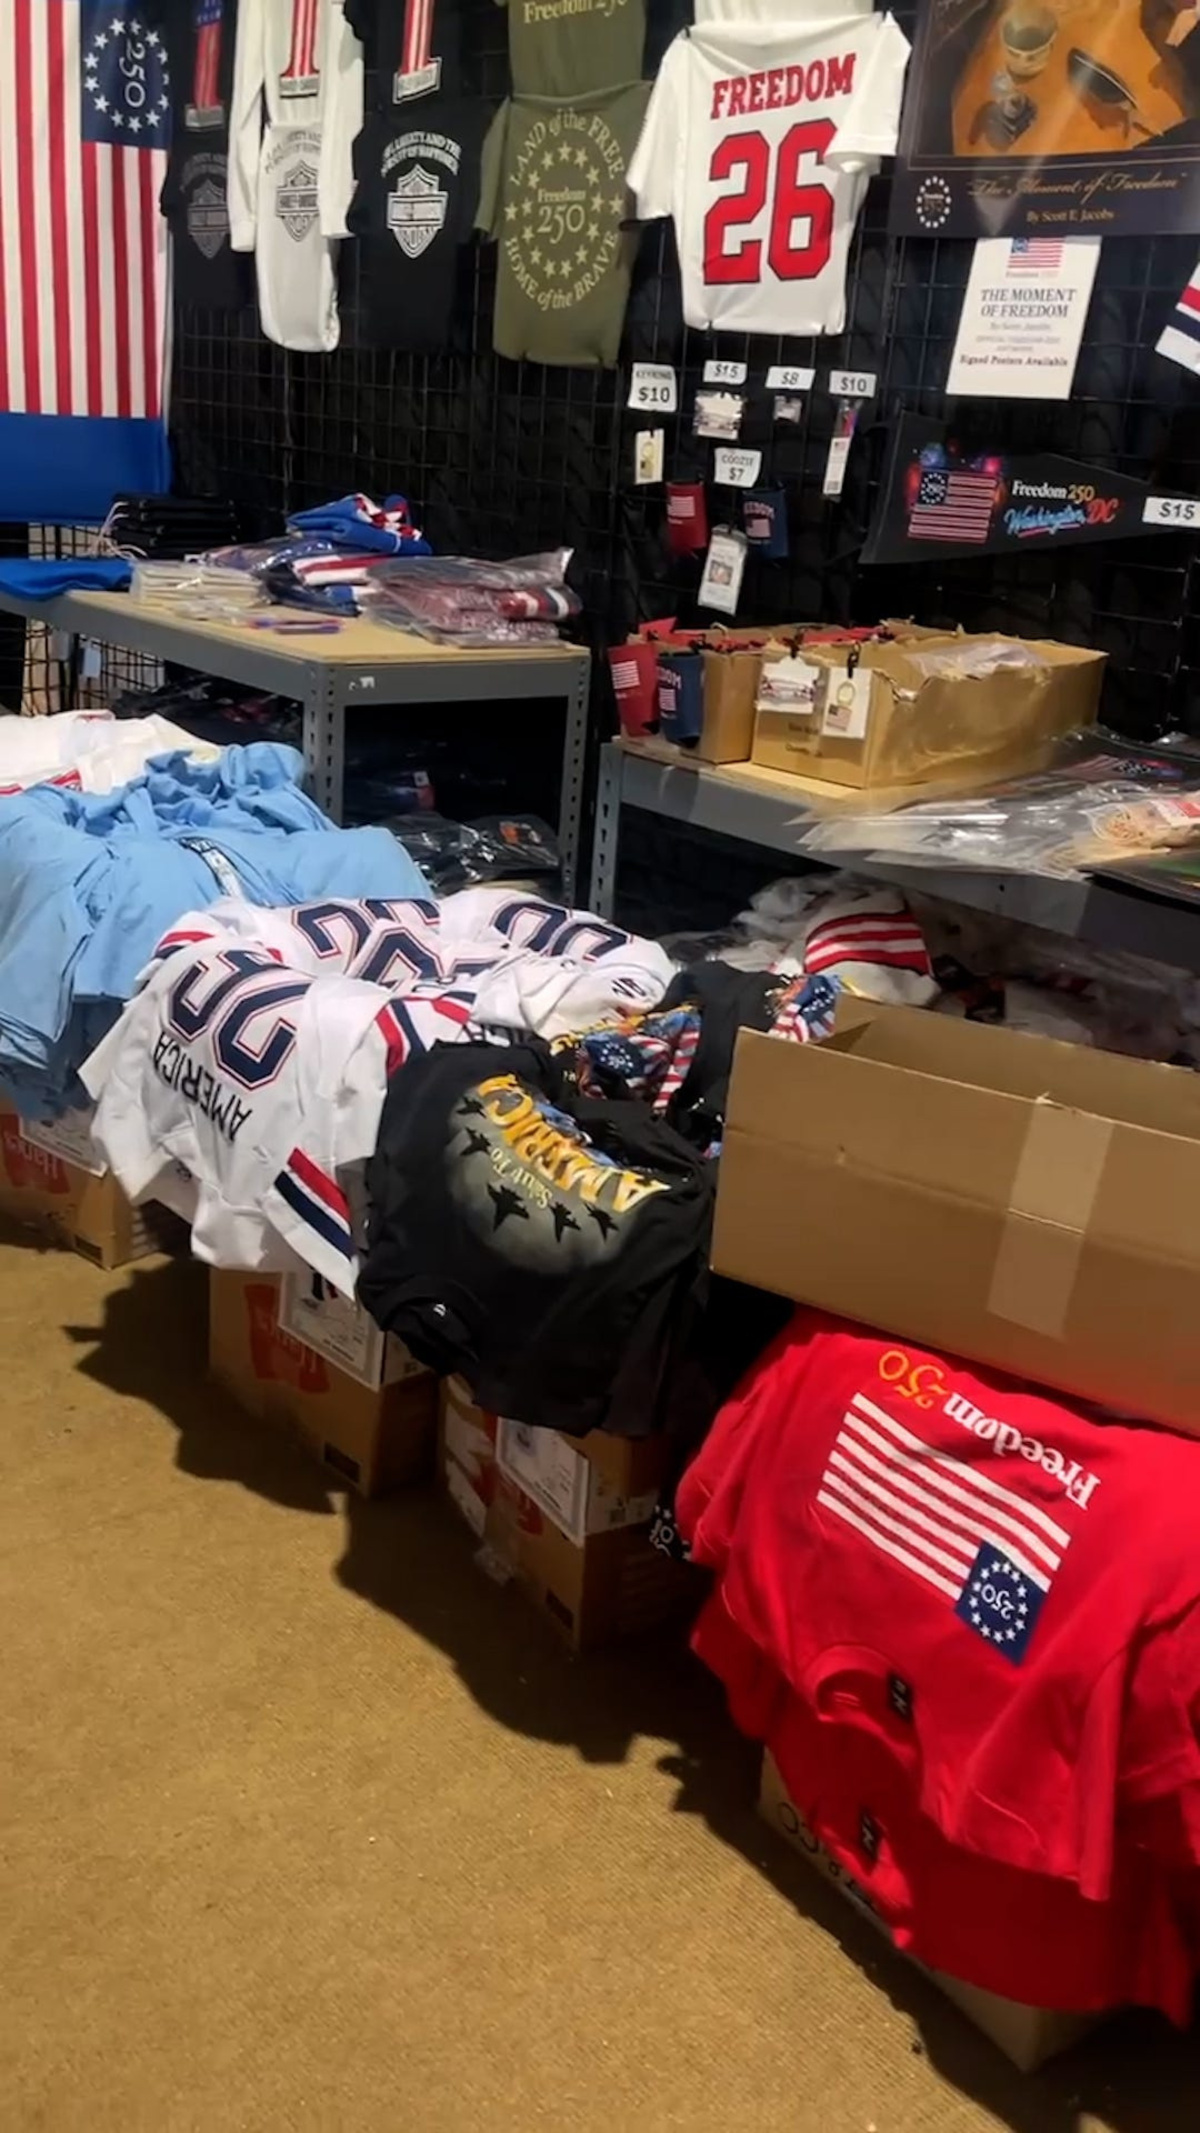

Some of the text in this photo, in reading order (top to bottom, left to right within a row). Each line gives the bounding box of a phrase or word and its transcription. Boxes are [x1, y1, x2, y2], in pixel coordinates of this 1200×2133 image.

[119, 39, 146, 108] 250
[711, 53, 856, 119] FREEDOM
[510, 121, 546, 186] LAND
[588, 115, 625, 180] FREE
[538, 187, 586, 202] Freedom
[703, 117, 838, 286] 26
[537, 204, 586, 244] 250
[1027, 211, 1039, 225] By
[1041, 211, 1067, 222] Scott
[1080, 209, 1114, 222] Jacobs
[504, 236, 539, 299] HOME
[574, 231, 620, 301] BRAVE
[981, 288, 1077, 302] THE MOMENT
[981, 304, 1069, 318] OF FREEDOM
[714, 363, 739, 378] $15
[782, 371, 800, 386] $8
[638, 387, 670, 403] $10
[841, 376, 867, 393] $10
[729, 467, 745, 482] $7
[1011, 480, 1096, 504] Freedom 250
[1003, 498, 1120, 536] Washington DC
[1158, 501, 1196, 521] $15
[153, 1031, 253, 1142] AMERICA
[878, 1350, 1102, 1511] Freedom 250
[981, 1583, 1016, 1620] 250
